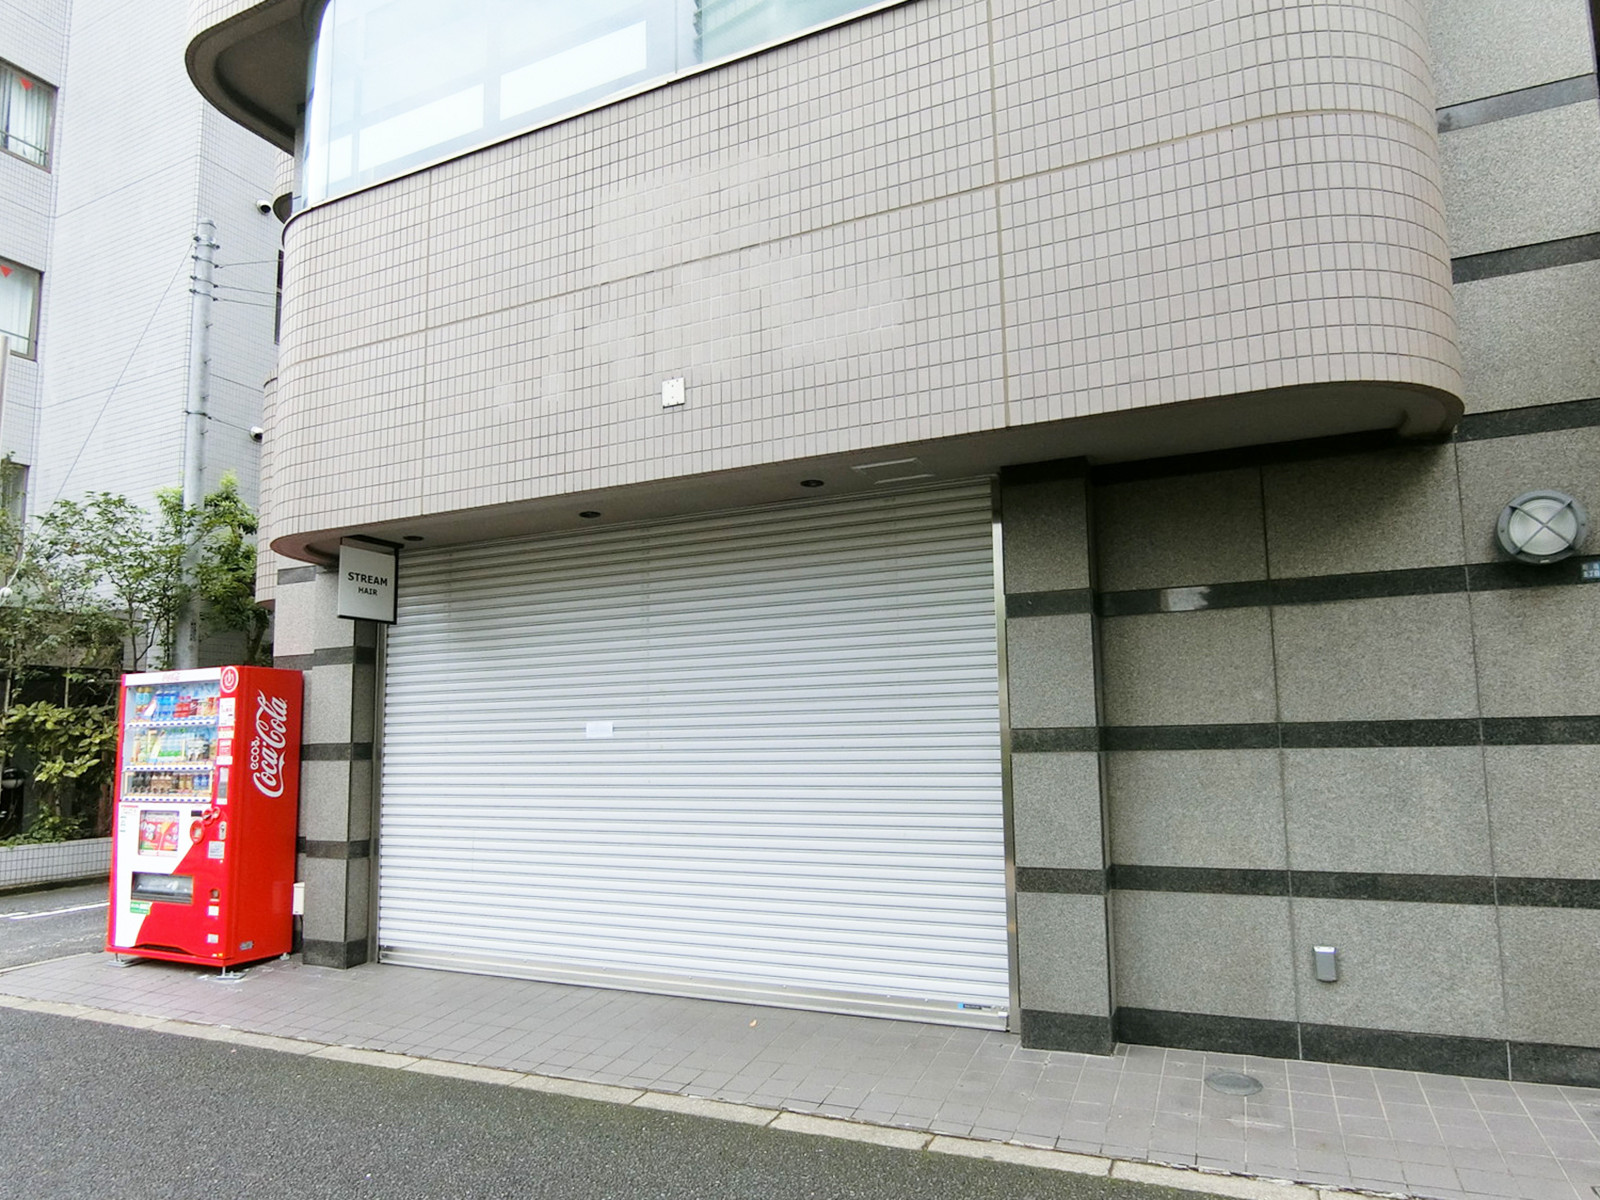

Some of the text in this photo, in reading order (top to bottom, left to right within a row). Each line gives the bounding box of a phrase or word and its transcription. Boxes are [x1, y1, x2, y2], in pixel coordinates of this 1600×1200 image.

[347, 571, 388, 587] STREAM
[358, 587, 378, 596] HAIR
[253, 689, 287, 798] Coca-Cola
